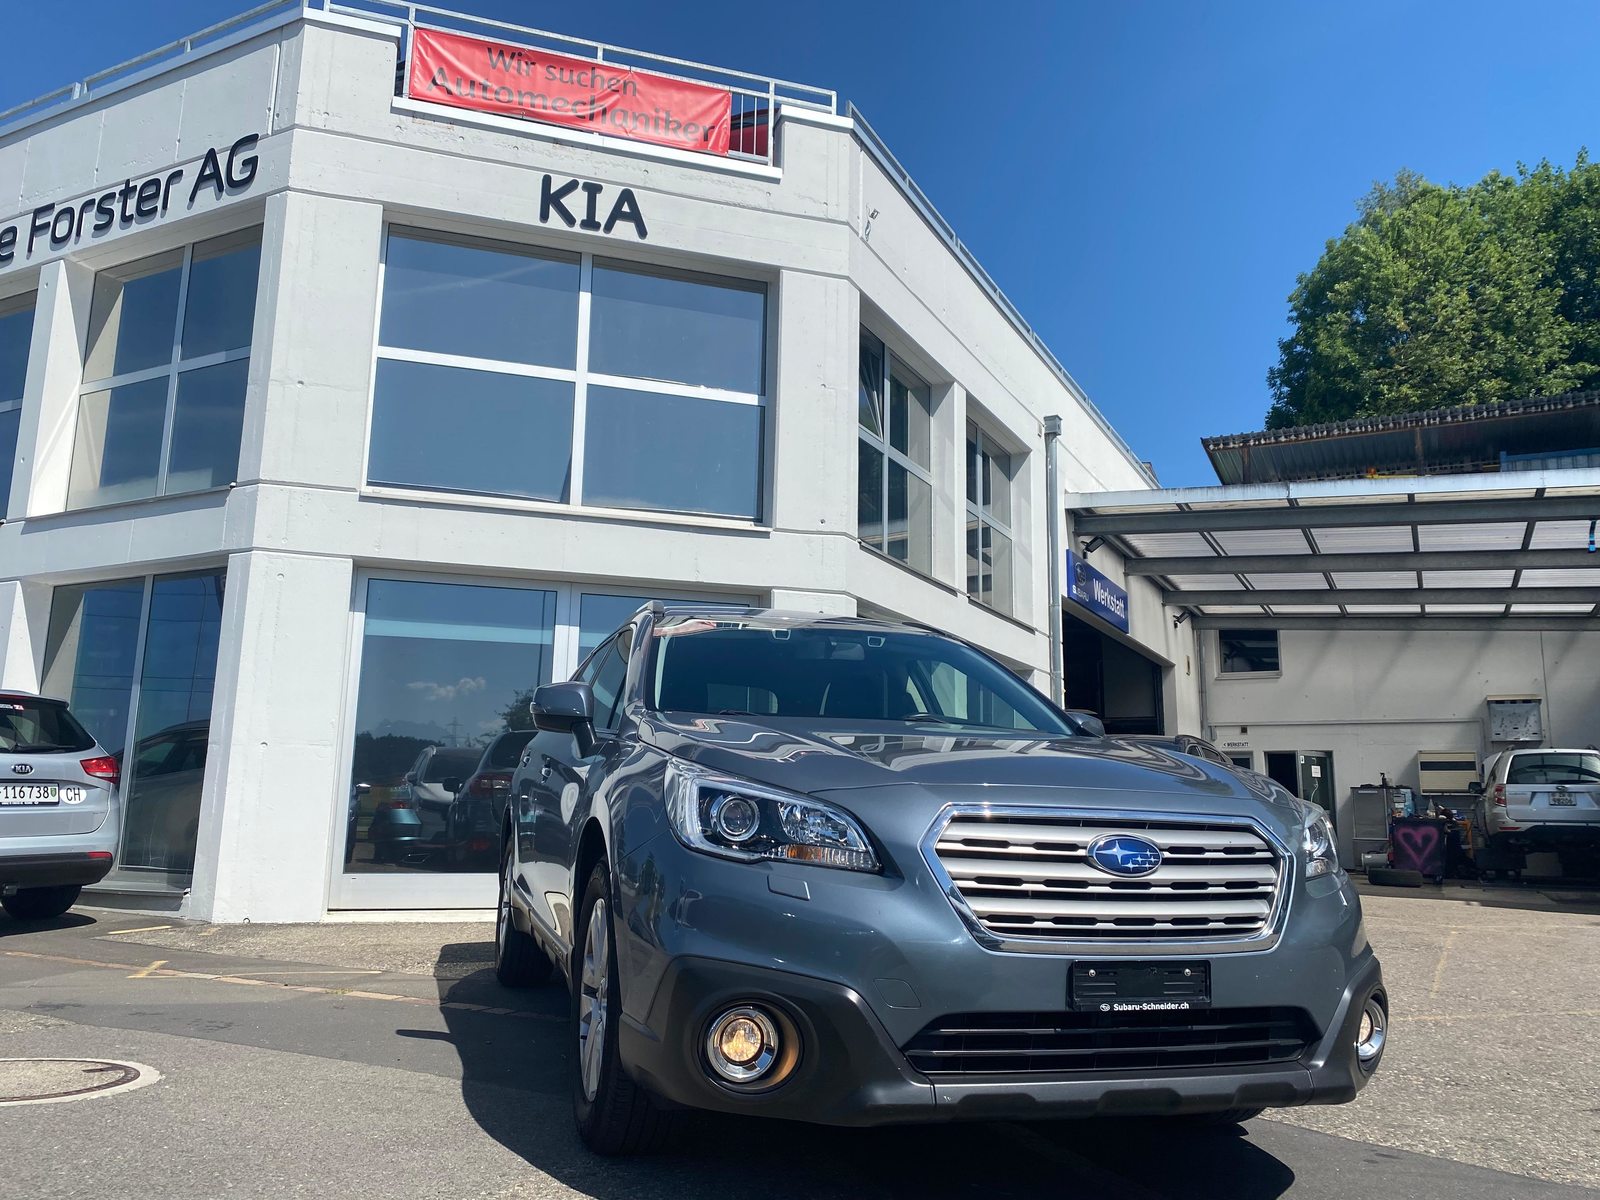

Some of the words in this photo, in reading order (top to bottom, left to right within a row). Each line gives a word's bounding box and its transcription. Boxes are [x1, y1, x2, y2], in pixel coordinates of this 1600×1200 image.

[486, 46, 536, 77] Wir
[544, 64, 637, 97] suchen
[426, 66, 716, 143] Automechaniker
[27, 185, 184, 253] Forster
[189, 133, 260, 203] AG
[539, 174, 648, 240] KIA
[1093, 578, 1125, 619] Werkstatt
[15, 765, 31, 773] KIA
[66, 787, 81, 801] CH
[1113, 1002, 1189, 1011] Subaru-Schneider.ch
